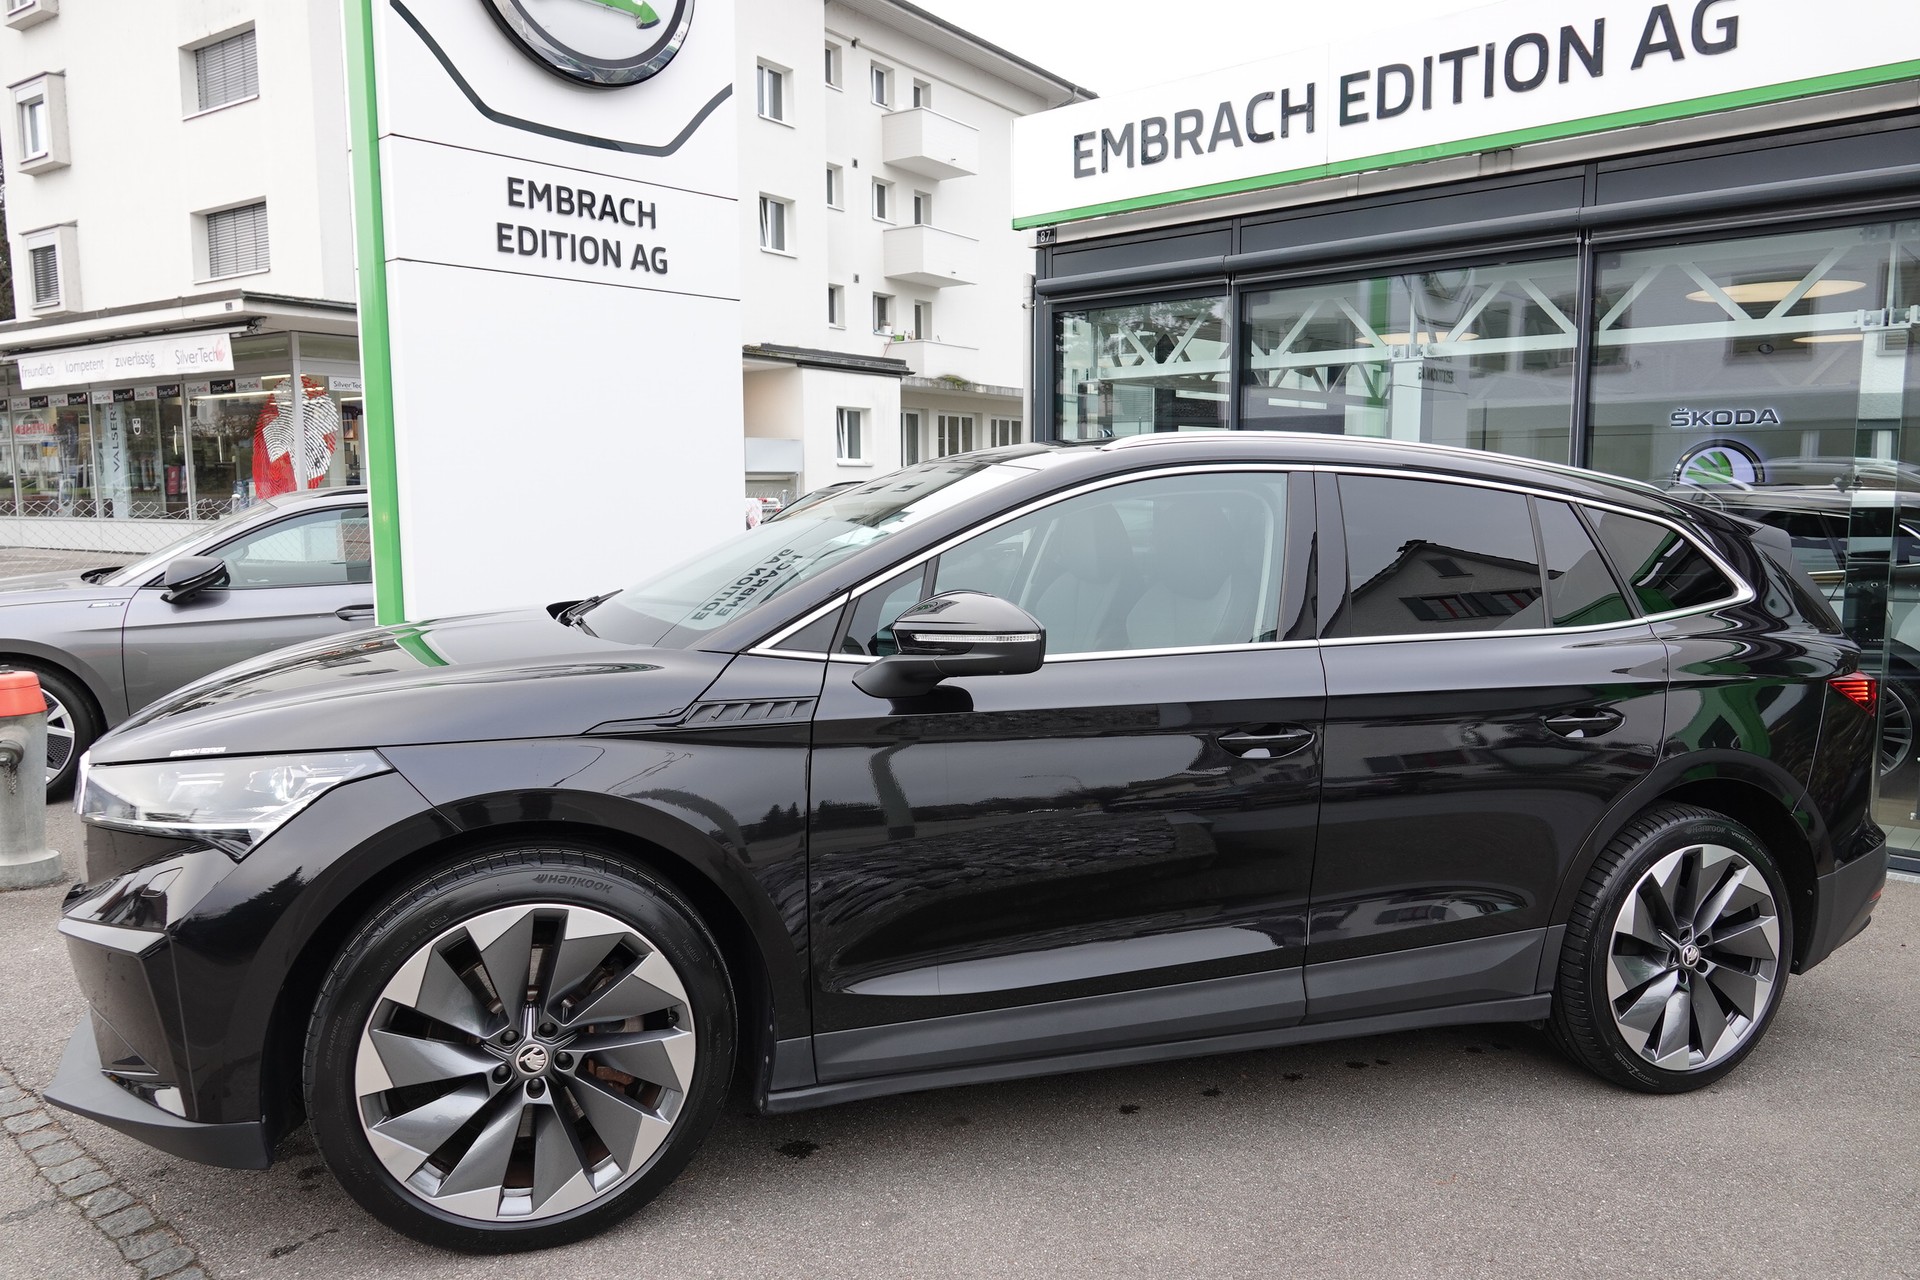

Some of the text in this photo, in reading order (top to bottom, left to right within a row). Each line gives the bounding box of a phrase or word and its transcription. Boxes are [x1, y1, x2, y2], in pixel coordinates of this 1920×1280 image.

[1074, 0, 1739, 179] EMBRACH EDITION AG
[507, 176, 656, 230] EMBRACH
[496, 222, 668, 275] EDITION AG
[1040, 230, 1051, 242] 87
[21, 362, 55, 379] freundlich
[65, 359, 104, 375] kompetent
[175, 345, 218, 365] SilverTech
[333, 380, 362, 389] SilverTec
[1670, 408, 1779, 427] ŠKODA
[109, 410, 120, 472] VALSER
